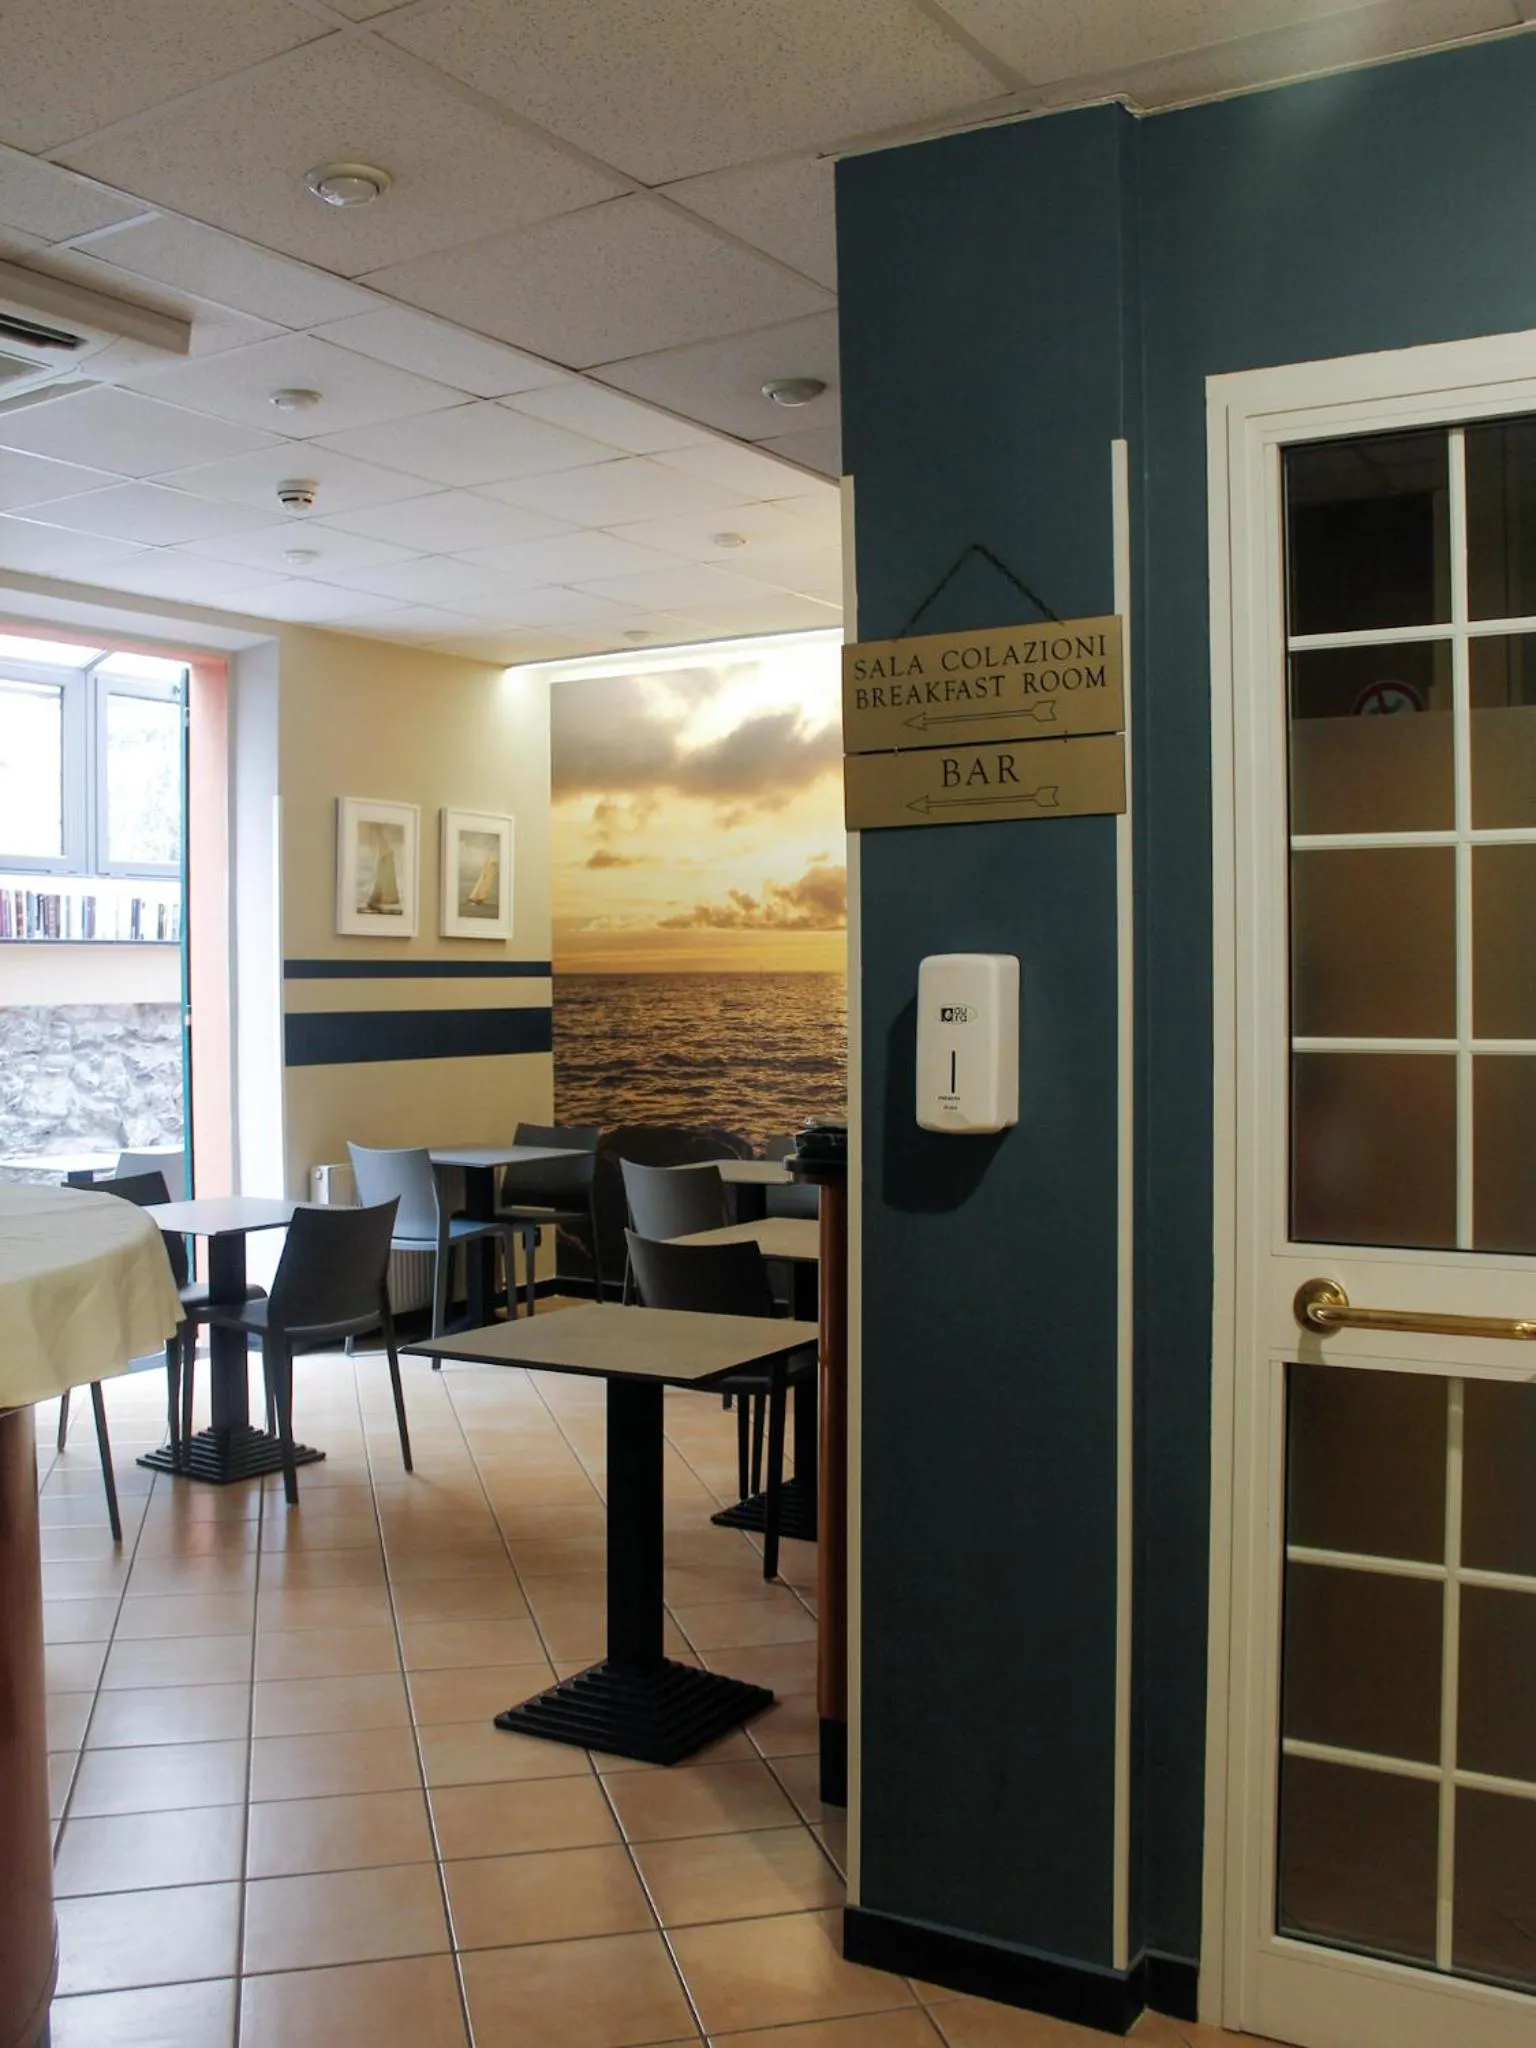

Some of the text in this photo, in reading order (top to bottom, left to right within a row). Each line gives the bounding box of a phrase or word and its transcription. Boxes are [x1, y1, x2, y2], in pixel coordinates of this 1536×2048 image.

[854, 634, 1106, 681] SALA COLAZIONI
[856, 665, 1107, 710] BREAKFAST ROOM
[941, 754, 1020, 788] BAR
